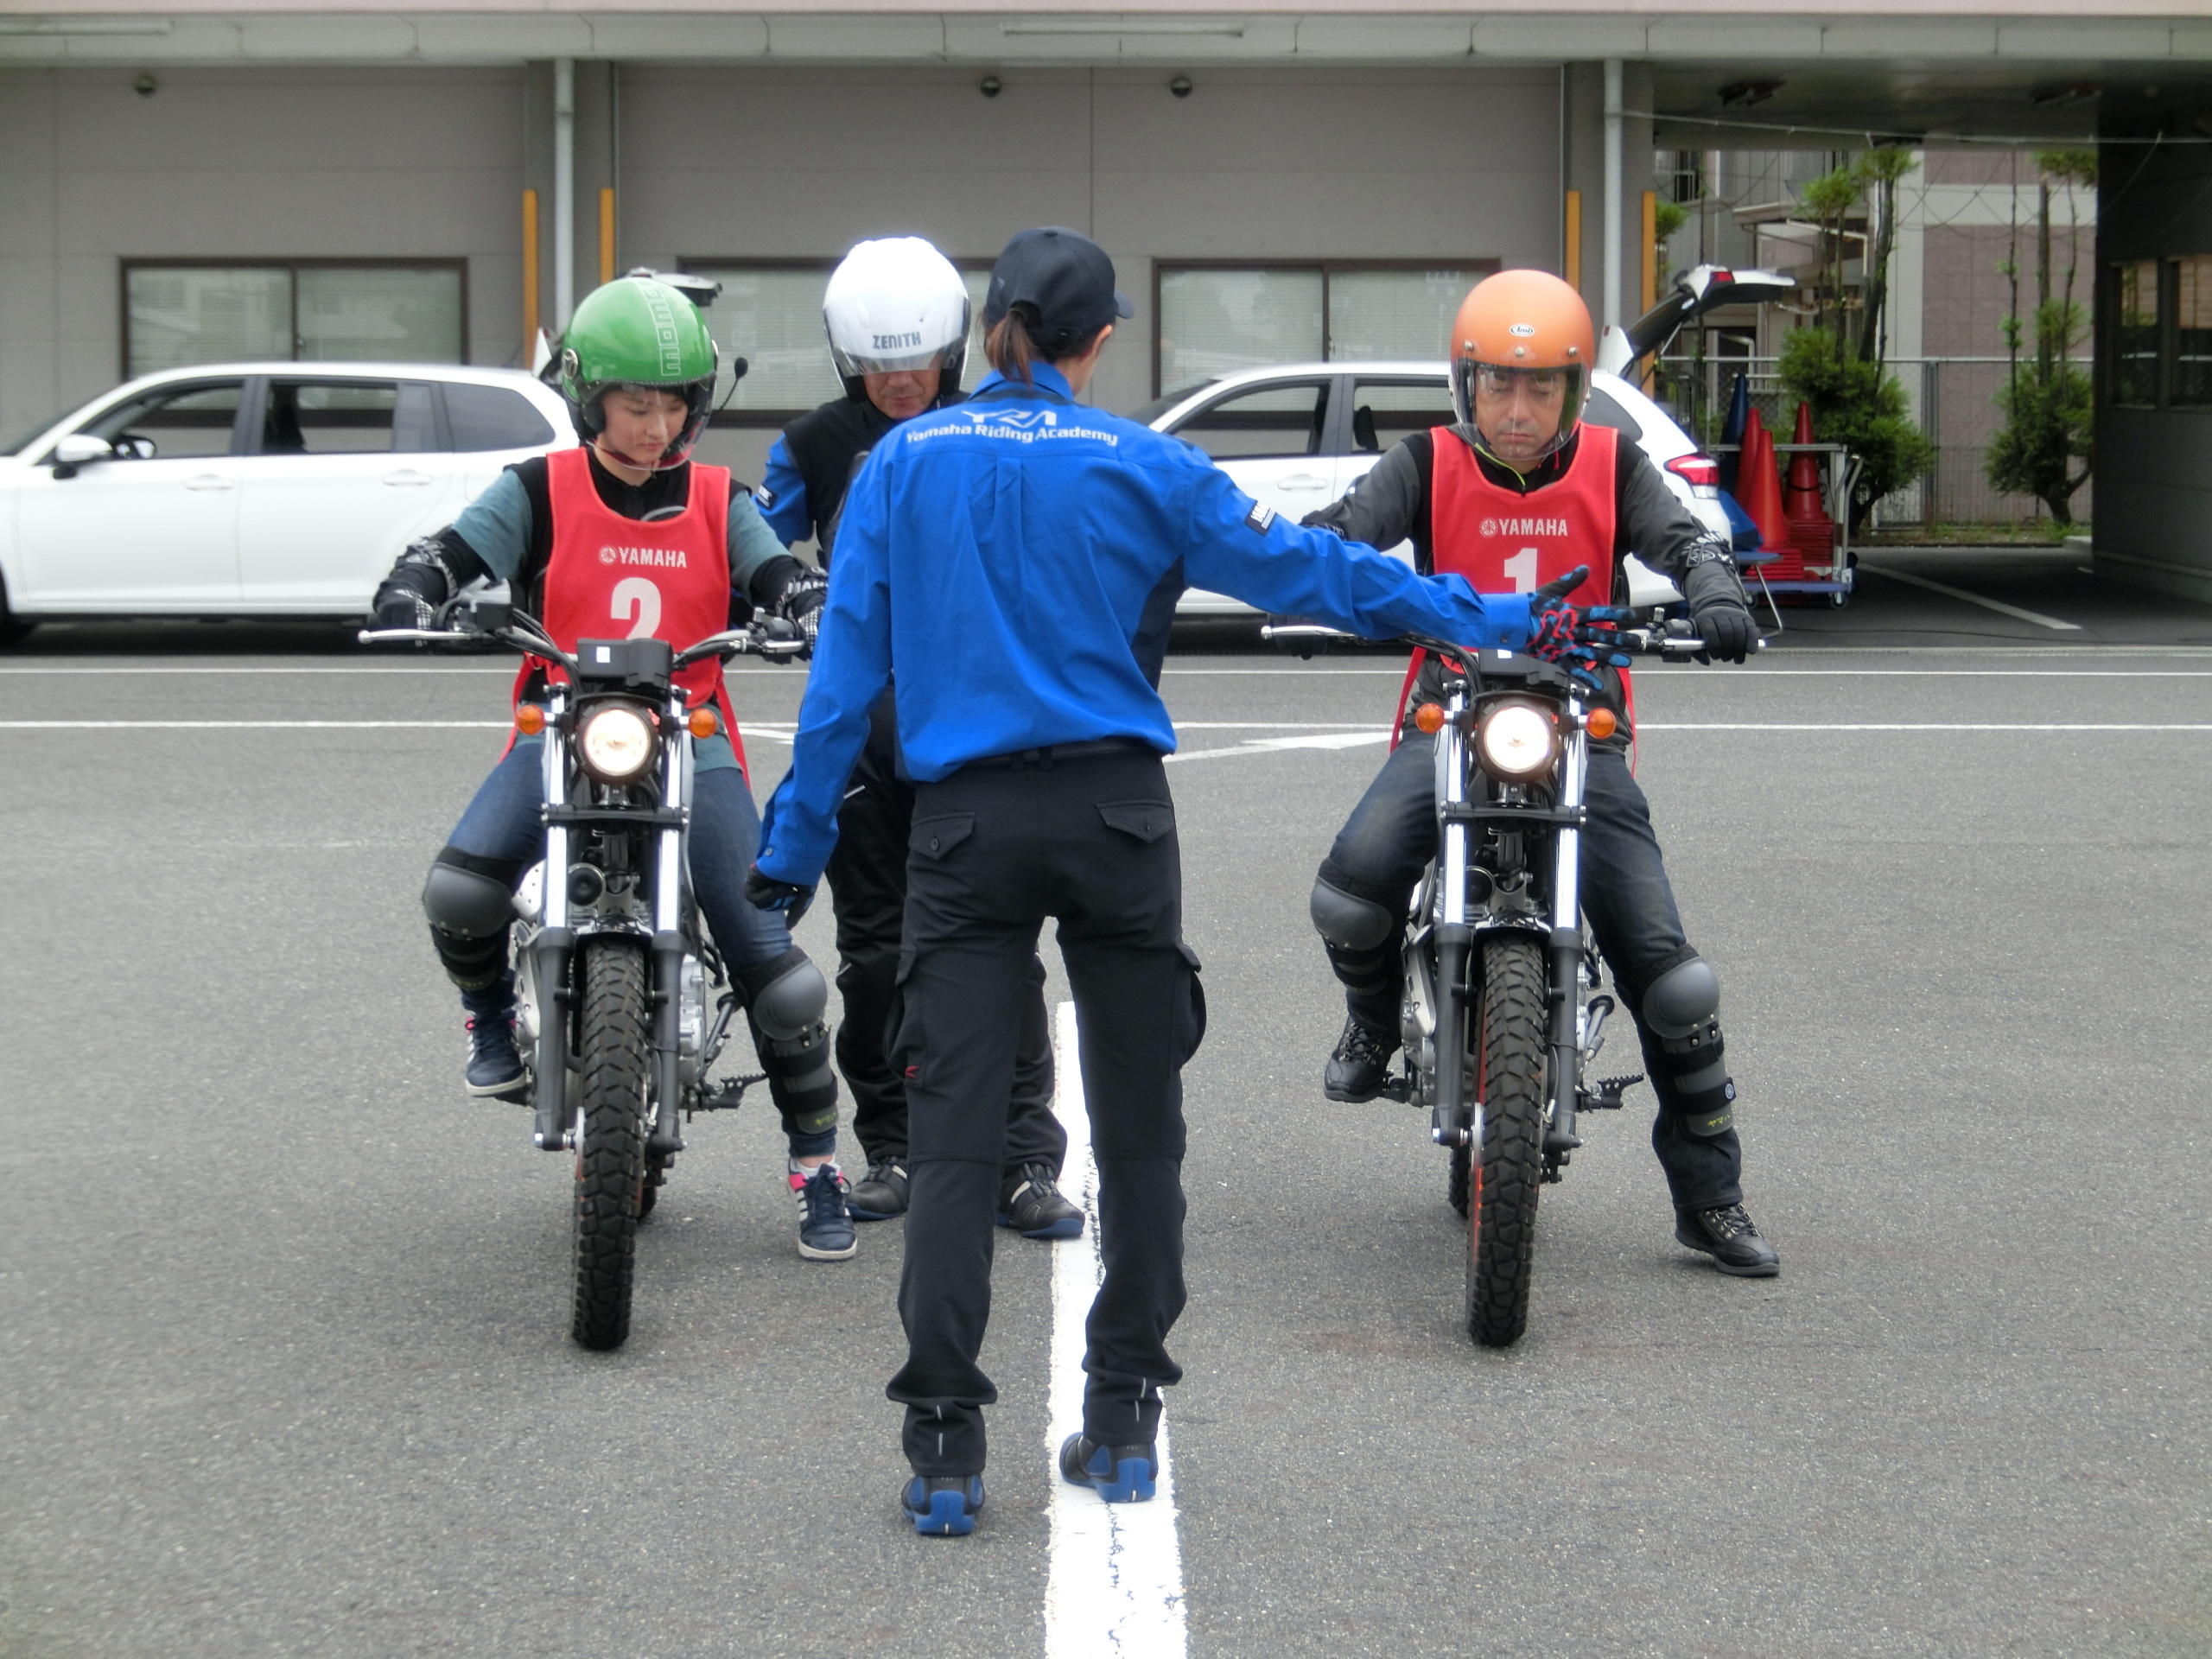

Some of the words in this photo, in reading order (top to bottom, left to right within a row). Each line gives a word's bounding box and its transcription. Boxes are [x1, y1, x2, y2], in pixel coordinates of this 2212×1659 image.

[872, 331, 921, 349] ZENITH
[906, 423, 971, 442] Yamaha
[975, 424, 1033, 443] Riding
[1037, 427, 1118, 447] Academy
[1498, 518, 1568, 536] YAMAHA
[619, 546, 687, 568] YAMAHA
[1503, 547, 1537, 594] 1
[610, 576, 662, 640] 2
